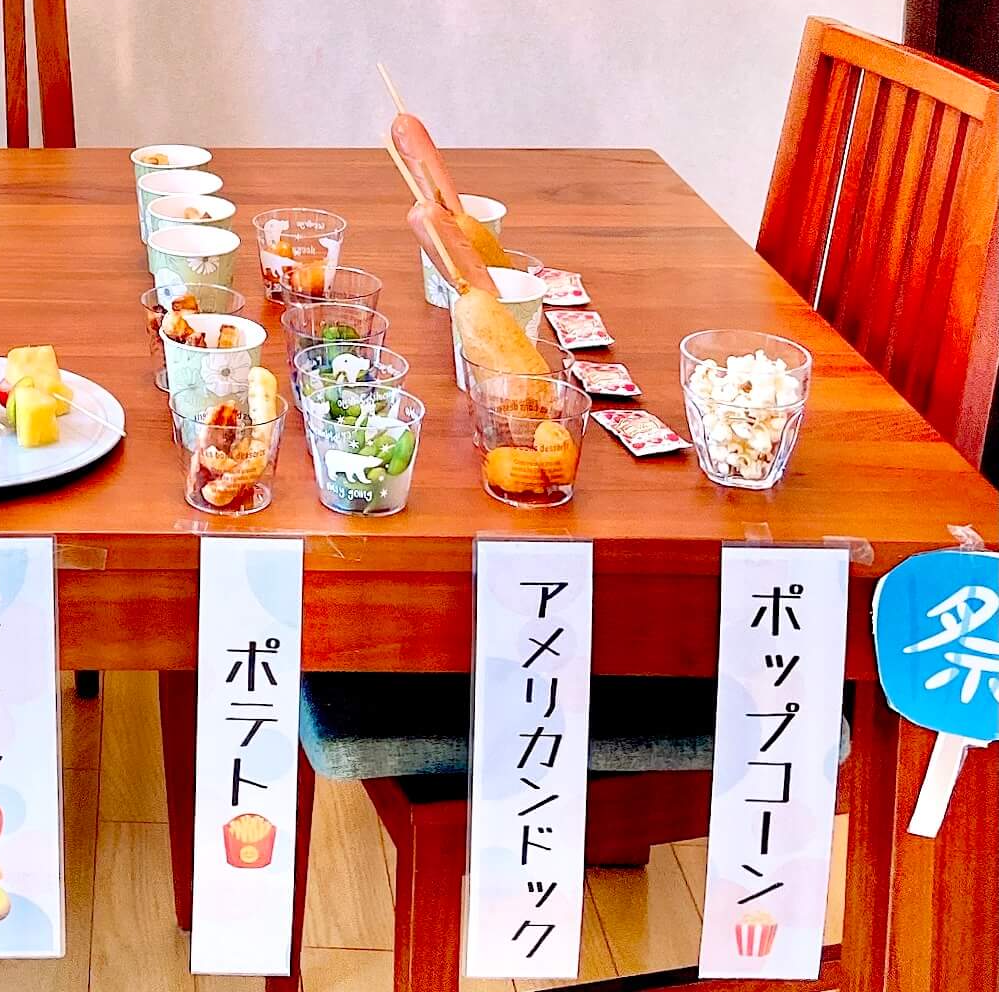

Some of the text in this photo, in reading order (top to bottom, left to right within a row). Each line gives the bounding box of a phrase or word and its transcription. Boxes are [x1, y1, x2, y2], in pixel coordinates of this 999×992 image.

[225, 637, 281, 806] ポテト
[511, 581, 569, 959] アメリカンドック
[737, 583, 804, 905] ポップコーン
